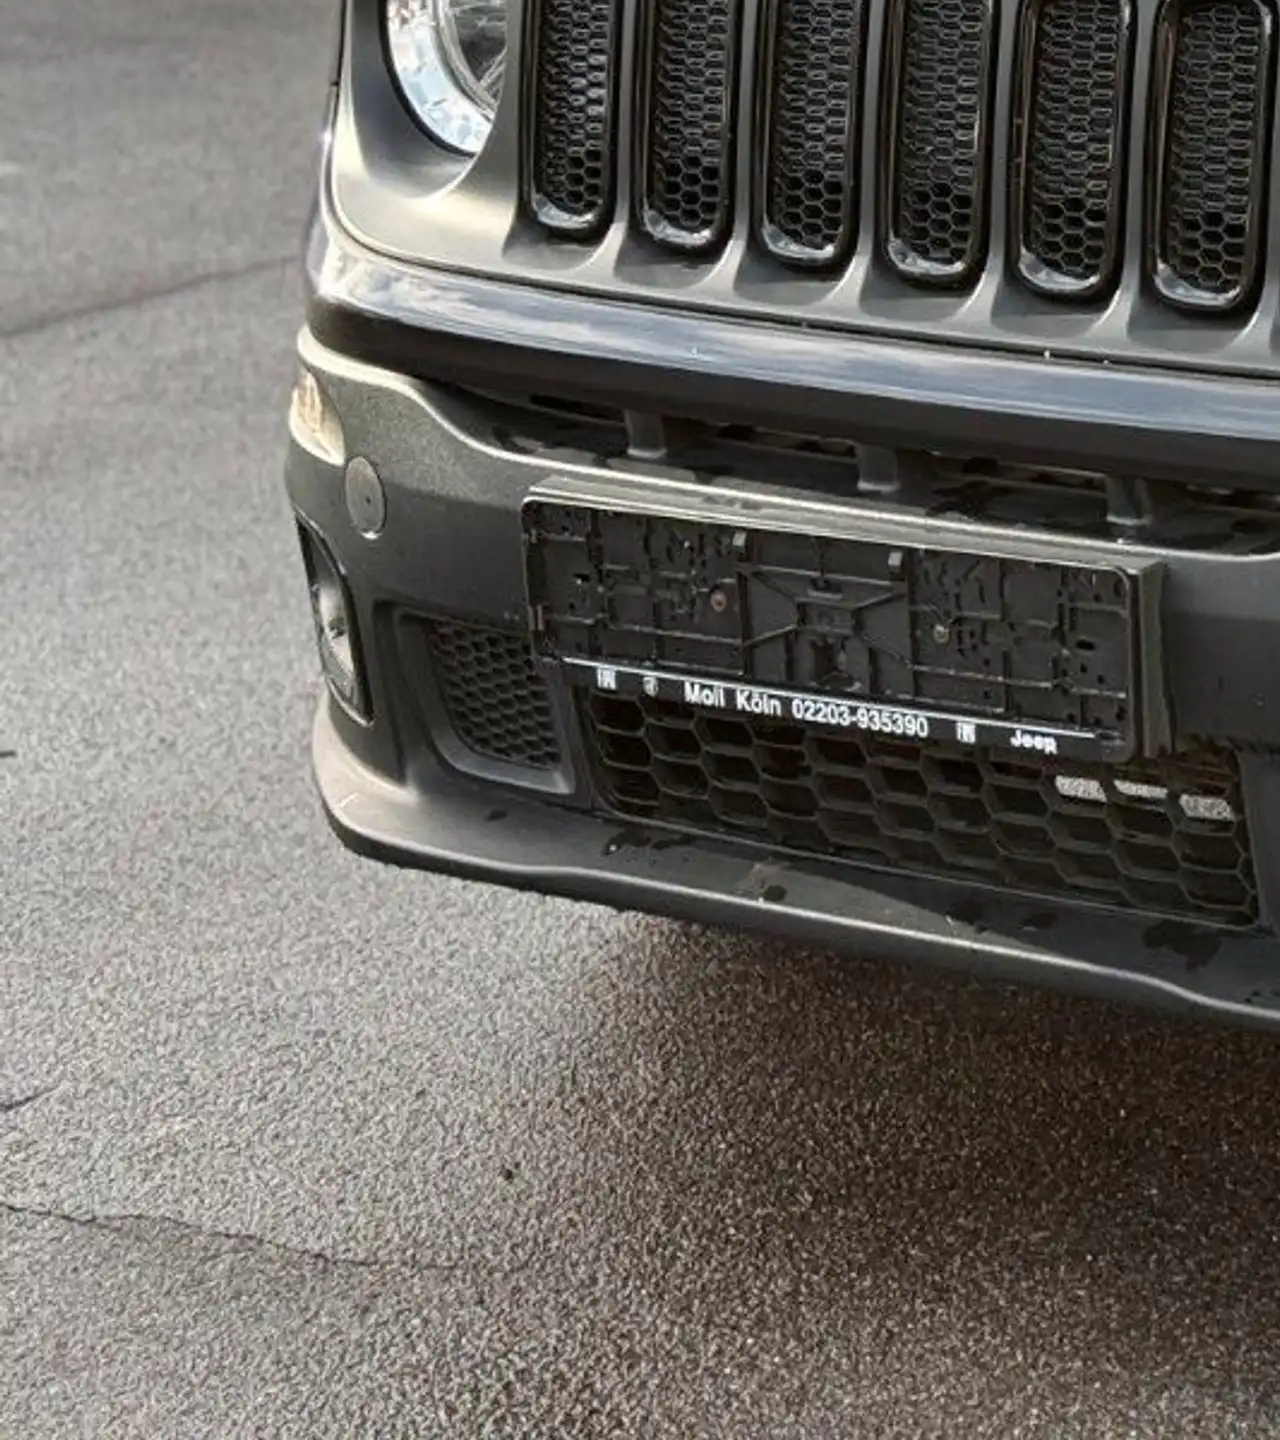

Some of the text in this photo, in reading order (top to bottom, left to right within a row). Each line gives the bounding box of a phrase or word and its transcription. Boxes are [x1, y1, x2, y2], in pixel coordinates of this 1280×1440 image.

[736, 687, 782, 717] Köln
[791, 697, 929, 738] 02203-935390
[1010, 729, 1058, 755] Jeep
